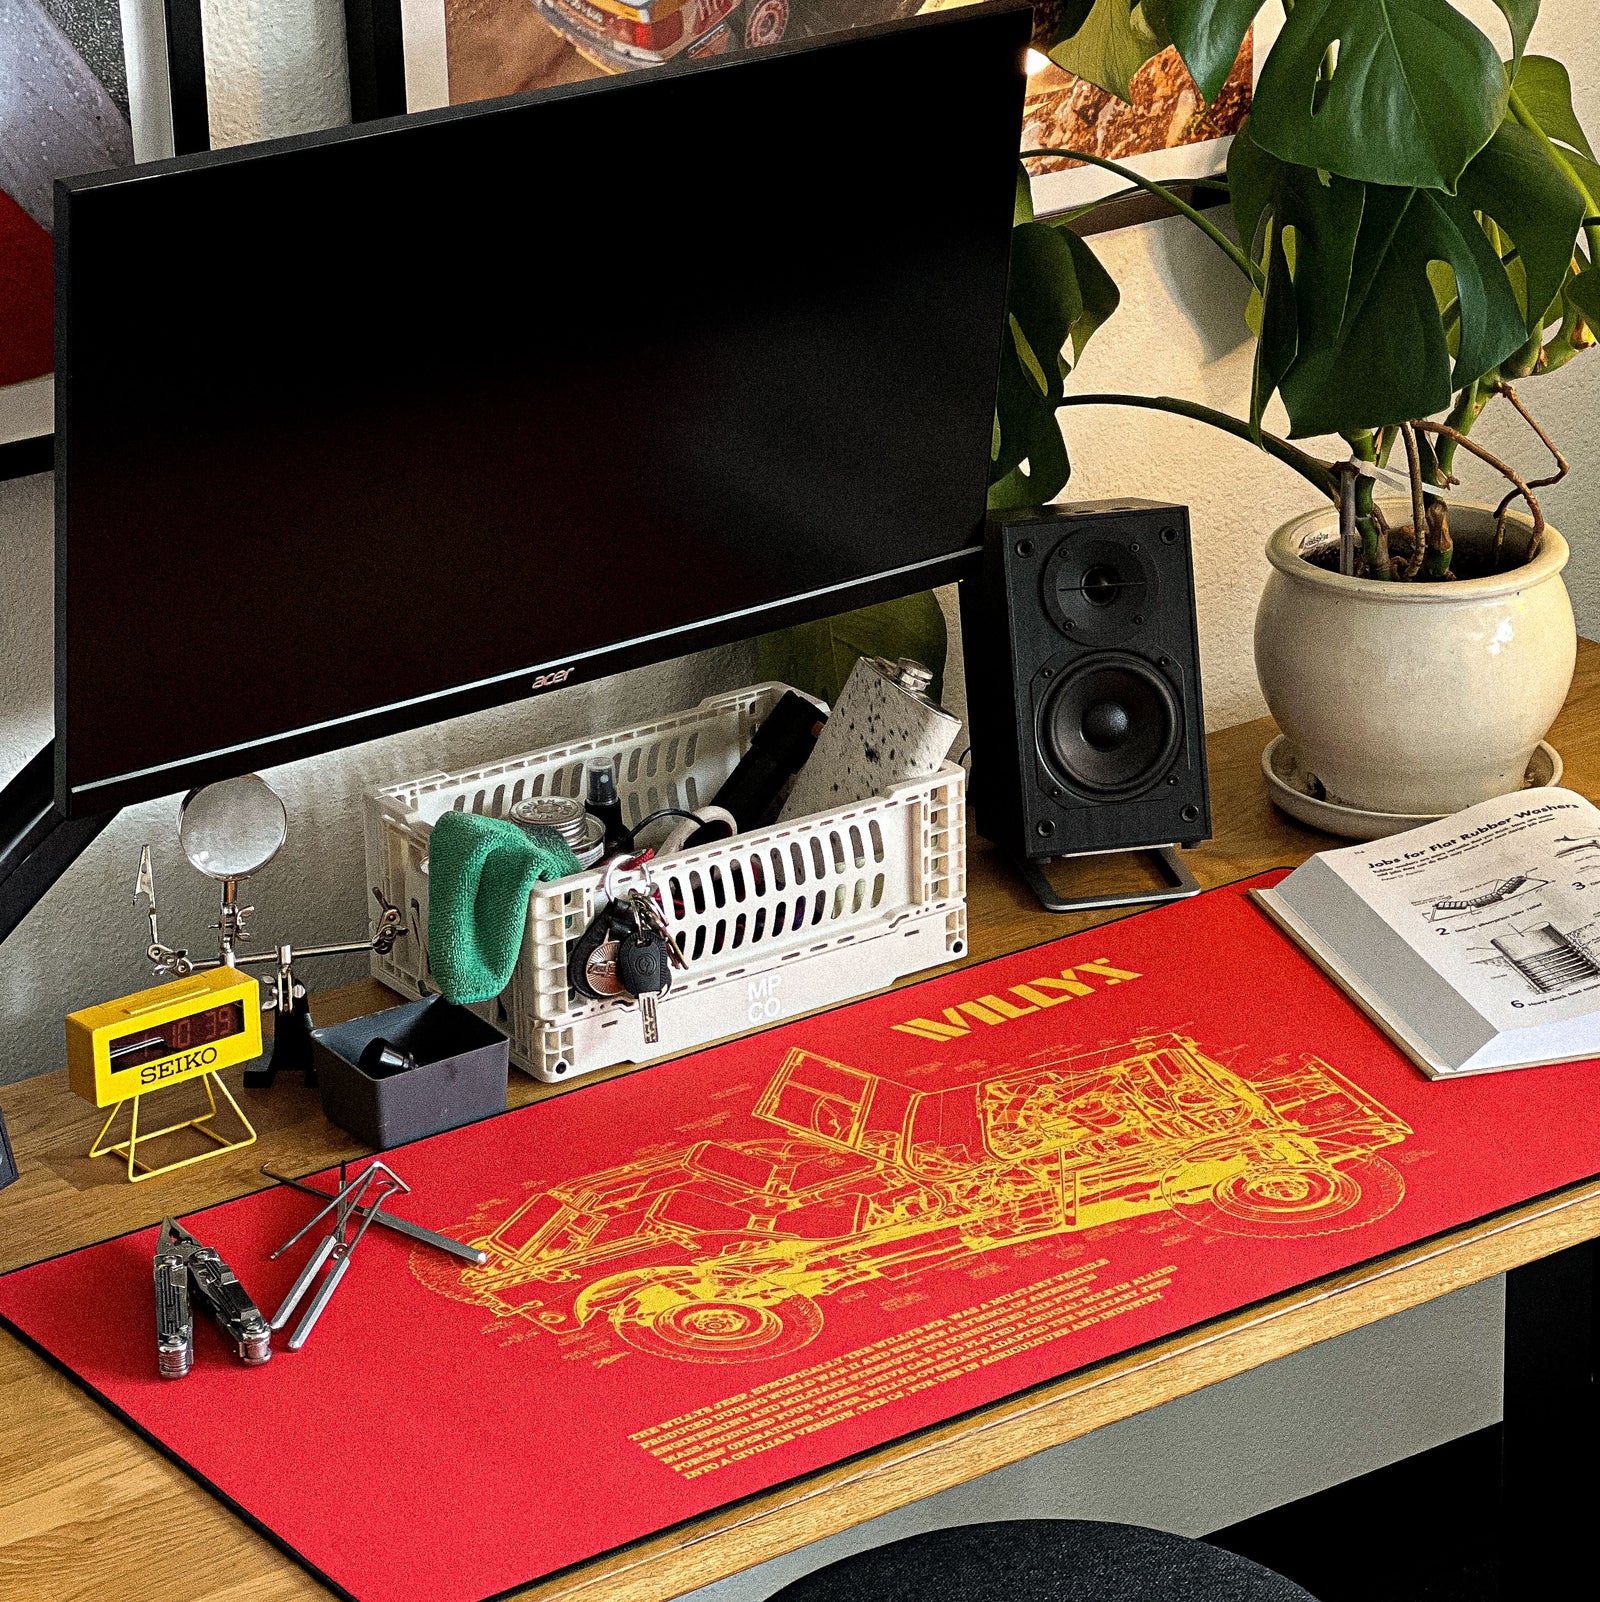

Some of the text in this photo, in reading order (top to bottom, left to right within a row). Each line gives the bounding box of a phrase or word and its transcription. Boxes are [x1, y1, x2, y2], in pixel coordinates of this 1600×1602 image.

[532, 667, 575, 689] acer
[1368, 803, 1580, 869] Jobs for Flat Rubber Washers
[1572, 881, 1586, 891] 3
[1435, 927, 1450, 936] 2
[748, 975, 781, 1001] MP
[889, 957, 1144, 1042] WILLYS
[1510, 999, 1525, 1009] 6
[140, 1047, 218, 1086] SEIKO
[627, 1426, 661, 1441] THE
[657, 1406, 713, 1429] WILLYS
[751, 1357, 843, 1395] SPECIFICALLY
[844, 1346, 875, 1360] THE
[871, 1327, 924, 1349] WILLYS
[947, 1306, 980, 1320] WAS
[980, 1302, 991, 1311] A
[989, 1278, 1053, 1306] MILITARY
[1053, 1258, 1110, 1281] VEHICLE
[639, 1418, 713, 1449] PRODUCED
[712, 1397, 768, 1421] DURING
[766, 1379, 816, 1400] WORLD
[814, 1367, 849, 1382] WAR
[862, 1351, 891, 1366] AND
[889, 1329, 948, 1354] BECAME
[947, 1325, 960, 1335] A
[957, 1306, 1012, 1329] SYMBOL
[1029, 1273, 1097, 1303] AMERICAN
[650, 1416, 749, 1456] ENGINEERING
[750, 1404, 781, 1419] AND
[779, 1377, 848, 1407] MILITARY
[945, 1311, 1026, 1344] CONSIDERED
[1025, 1300, 1055, 1314] THE
[1052, 1286, 1091, 1304] FIRST
[660, 1417, 775, 1464] MASS-PRODUCED
[906, 1357, 936, 1371] CAR
[935, 1345, 965, 1360] AND
[963, 1326, 1016, 1349] PLAYED
[1016, 1321, 1029, 1330] A
[1026, 1302, 1083, 1325] CRUCIAL
[1081, 1288, 1116, 1304] ROLE
[1132, 1265, 1178, 1286] ALLIED
[864, 1348, 989, 1397] WILLYS-OVERLAND
[989, 1325, 1049, 1351] ADAPTED
[1047, 1314, 1077, 1327] THE
[1075, 1290, 1139, 1317] MILITARY
[682, 1462, 720, 1480] INTO
[720, 1457, 734, 1468] A
[731, 1433, 795, 1461] CIVILIAN
[856, 1397, 889, 1412] THE
[907, 1379, 938, 1393] FOR
[935, 1368, 964, 1382] USE
[981, 1327, 1071, 1366] AGRICULTURE
[1071, 1316, 1100, 1331] AND
[1099, 1292, 1163, 1320] INDUSTRY
